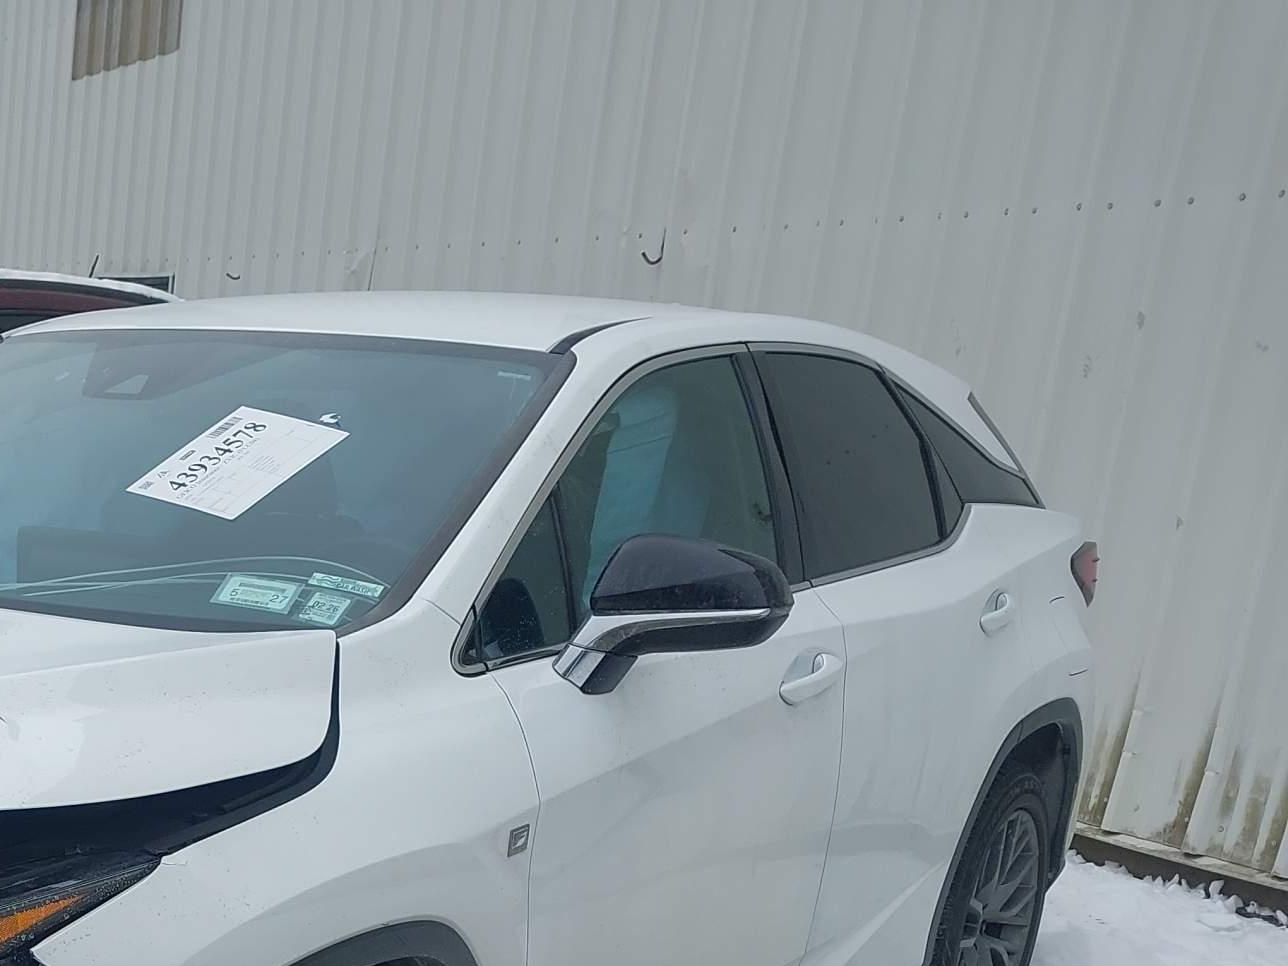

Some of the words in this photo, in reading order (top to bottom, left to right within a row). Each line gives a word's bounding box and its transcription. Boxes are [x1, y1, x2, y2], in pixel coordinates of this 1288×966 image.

[169, 422, 267, 491] 43934578
[230, 588, 240, 597] 5
[269, 594, 289, 604] 27
